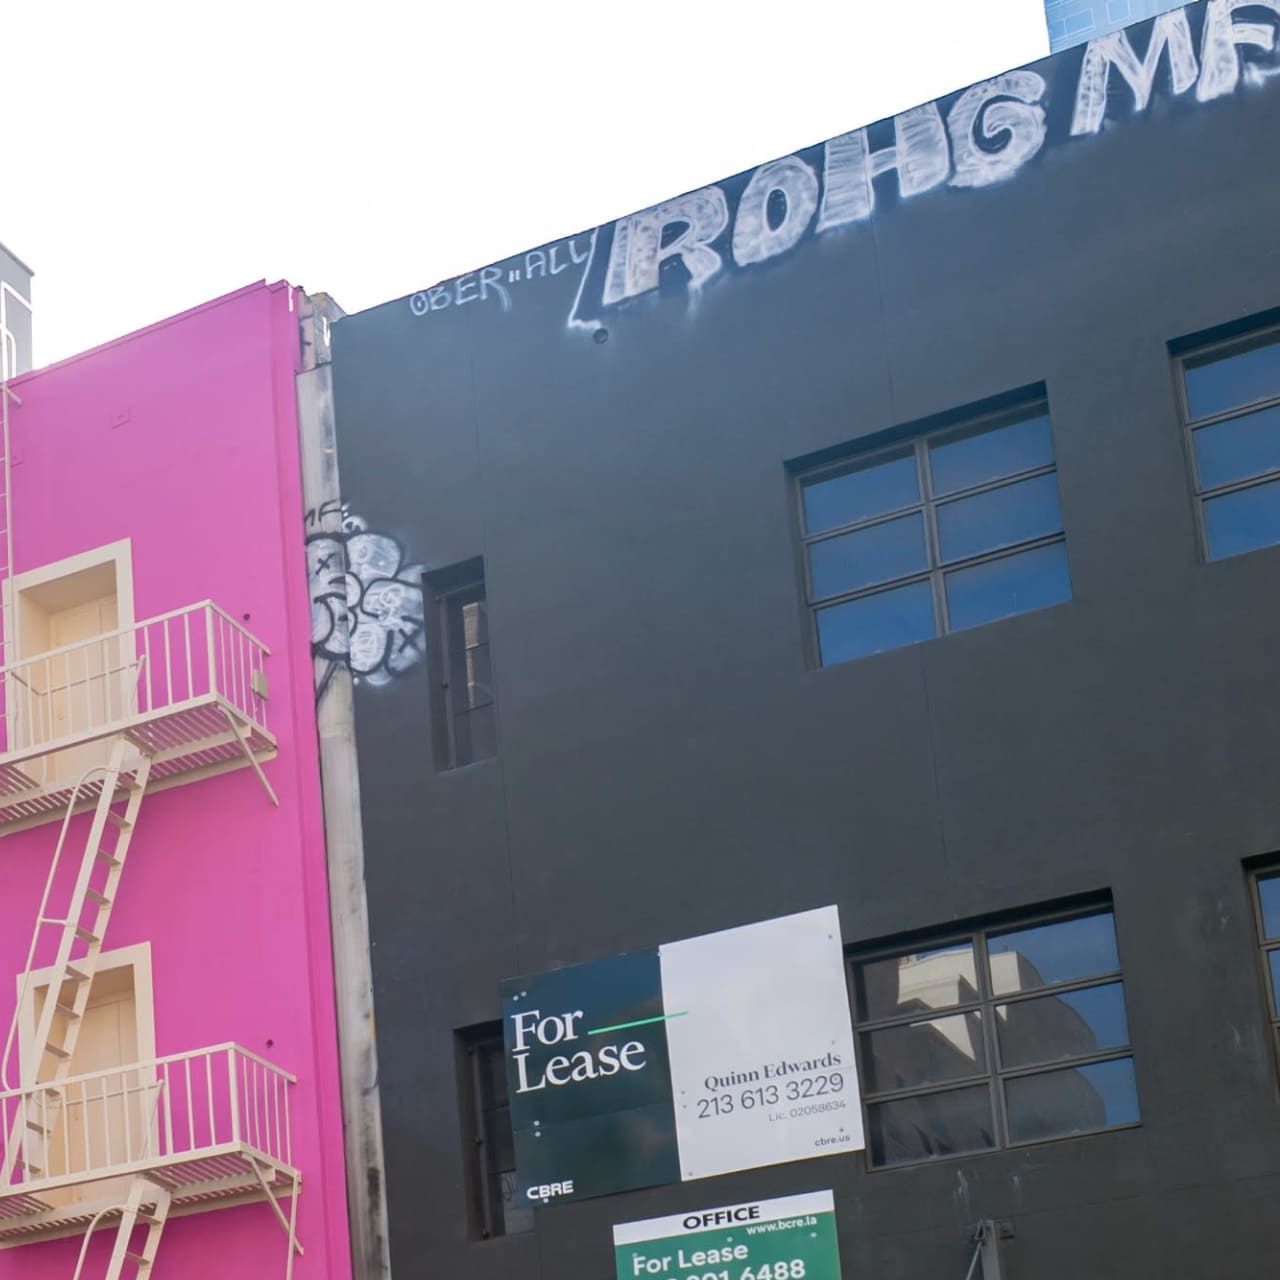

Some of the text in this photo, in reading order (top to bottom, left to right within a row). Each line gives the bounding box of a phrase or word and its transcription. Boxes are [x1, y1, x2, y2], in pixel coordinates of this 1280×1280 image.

[511, 1009, 584, 1052] For
[513, 1039, 646, 1093] Lease
[704, 1052, 842, 1092] Quinn Edwards
[697, 1073, 844, 1120] 213 613 3229
[814, 1133, 851, 1148] cbre.us
[527, 1180, 574, 1200] CBRE
[683, 1206, 760, 1230] OFFICE
[746, 1215, 817, 1236] www.bcre.la
[633, 1244, 749, 1276] For Lease
